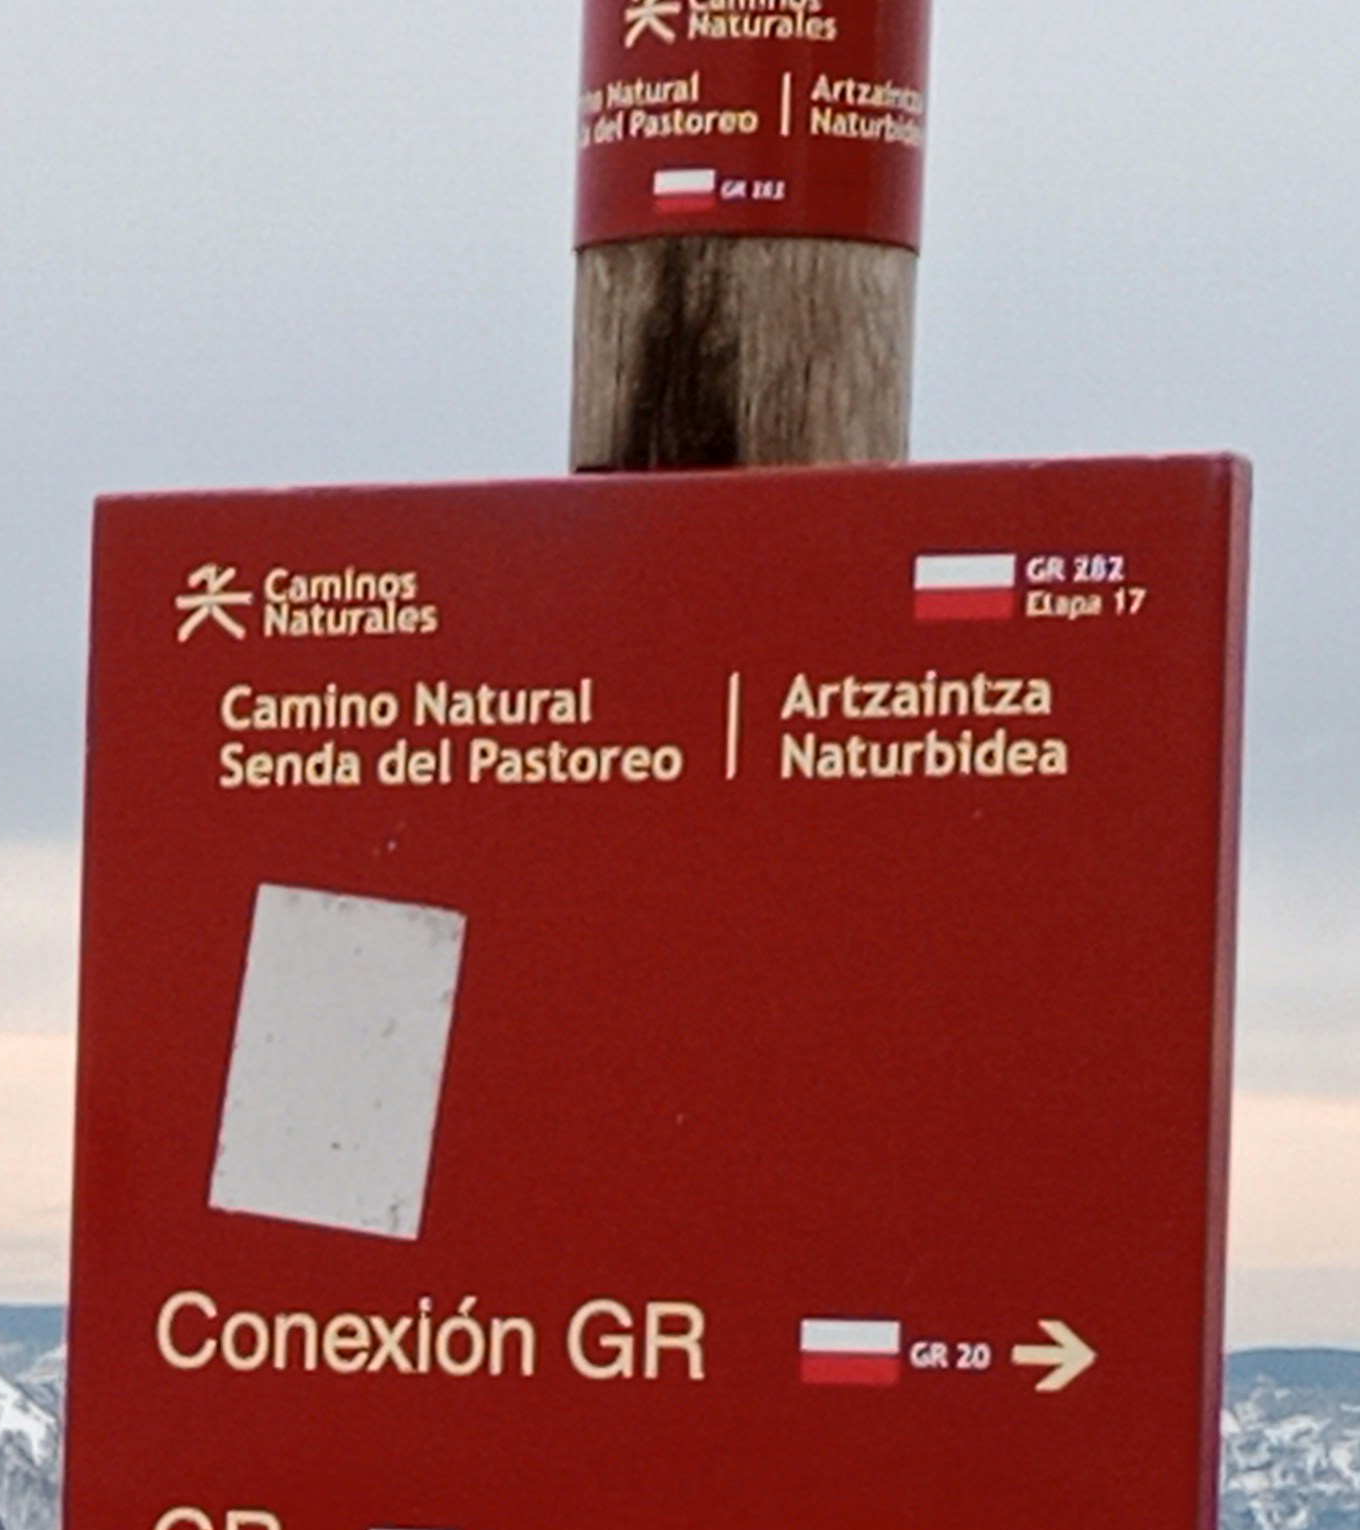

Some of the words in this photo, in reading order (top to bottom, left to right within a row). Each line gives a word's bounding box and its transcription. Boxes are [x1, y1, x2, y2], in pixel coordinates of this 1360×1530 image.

[688, 10, 837, 41] Naturales
[606, 70, 700, 109] Natural
[629, 107, 759, 138] Pastoreo
[263, 565, 418, 604] Caminos
[1025, 556, 1065, 582] GR
[1073, 555, 1125, 582] 282
[263, 600, 439, 638] Naturales
[1025, 590, 1103, 621] Etapa
[1112, 587, 1147, 616] 17
[220, 682, 400, 731] Camino
[412, 677, 593, 727] Natural
[780, 670, 1053, 720] Artzaintza
[218, 740, 362, 788] Senda
[376, 739, 452, 786] del
[468, 738, 684, 785] Pastoreo
[780, 727, 1069, 780] Naturbidea
[156, 1290, 536, 1376] Conexión
[567, 1299, 706, 1381] GR
[908, 1341, 950, 1370] GR
[956, 1342, 992, 1370] 20
